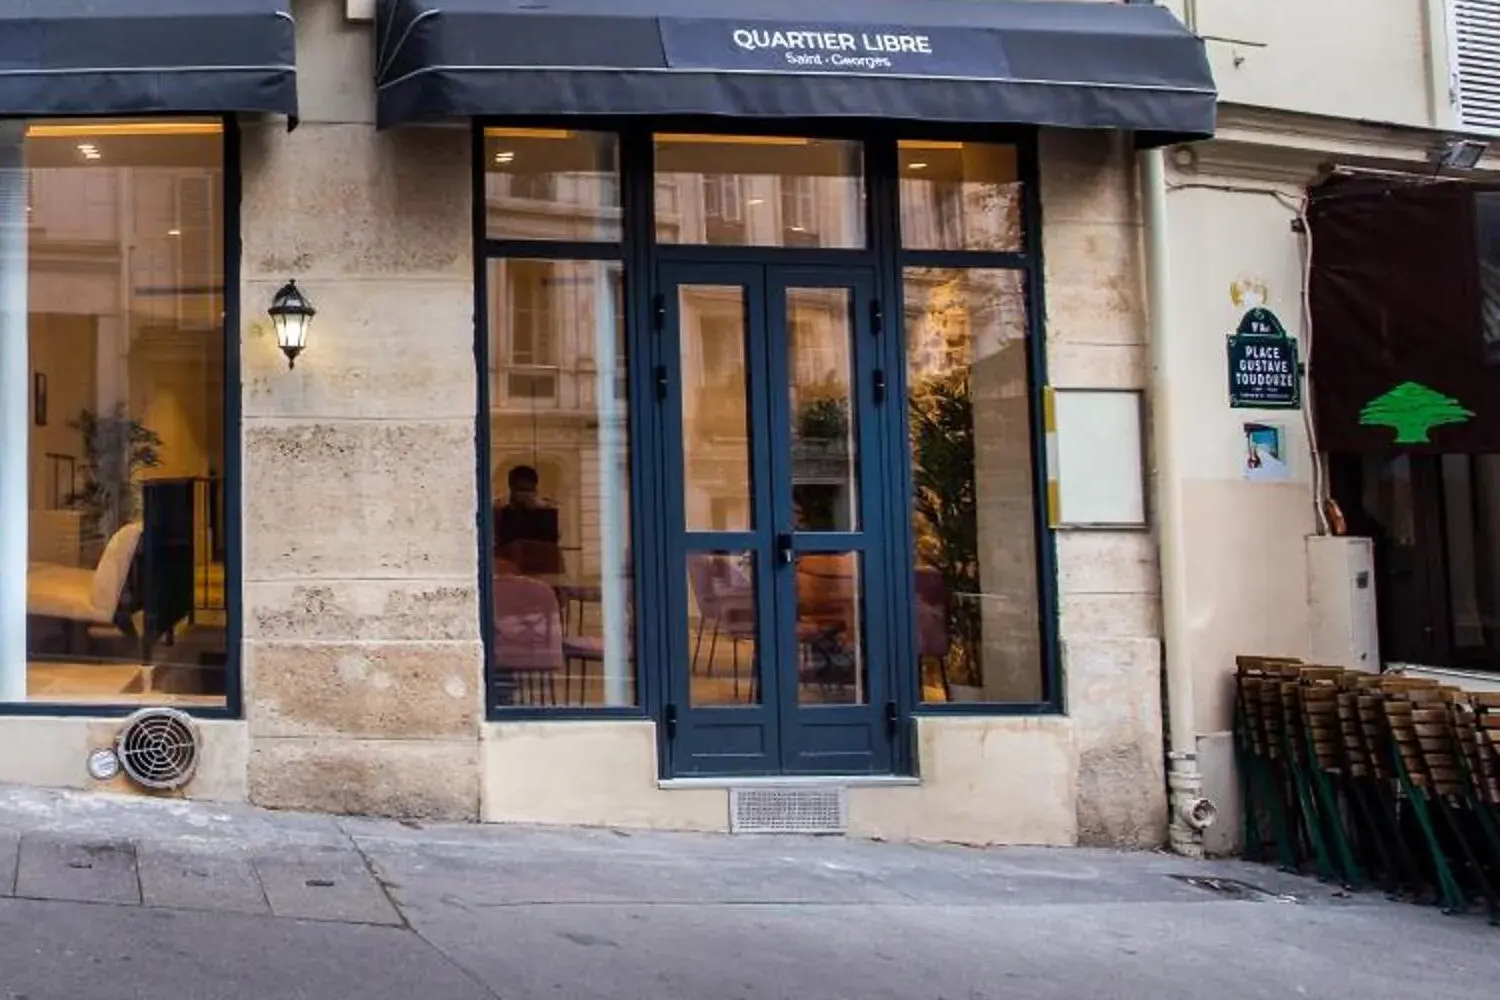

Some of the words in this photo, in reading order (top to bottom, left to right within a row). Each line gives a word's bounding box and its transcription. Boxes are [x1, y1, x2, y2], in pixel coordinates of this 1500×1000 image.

[732, 29, 857, 51] QUARTIER
[862, 33, 933, 53] LIBRE
[1245, 345, 1281, 359] PLACE
[1239, 359, 1289, 373] GUSTAVE
